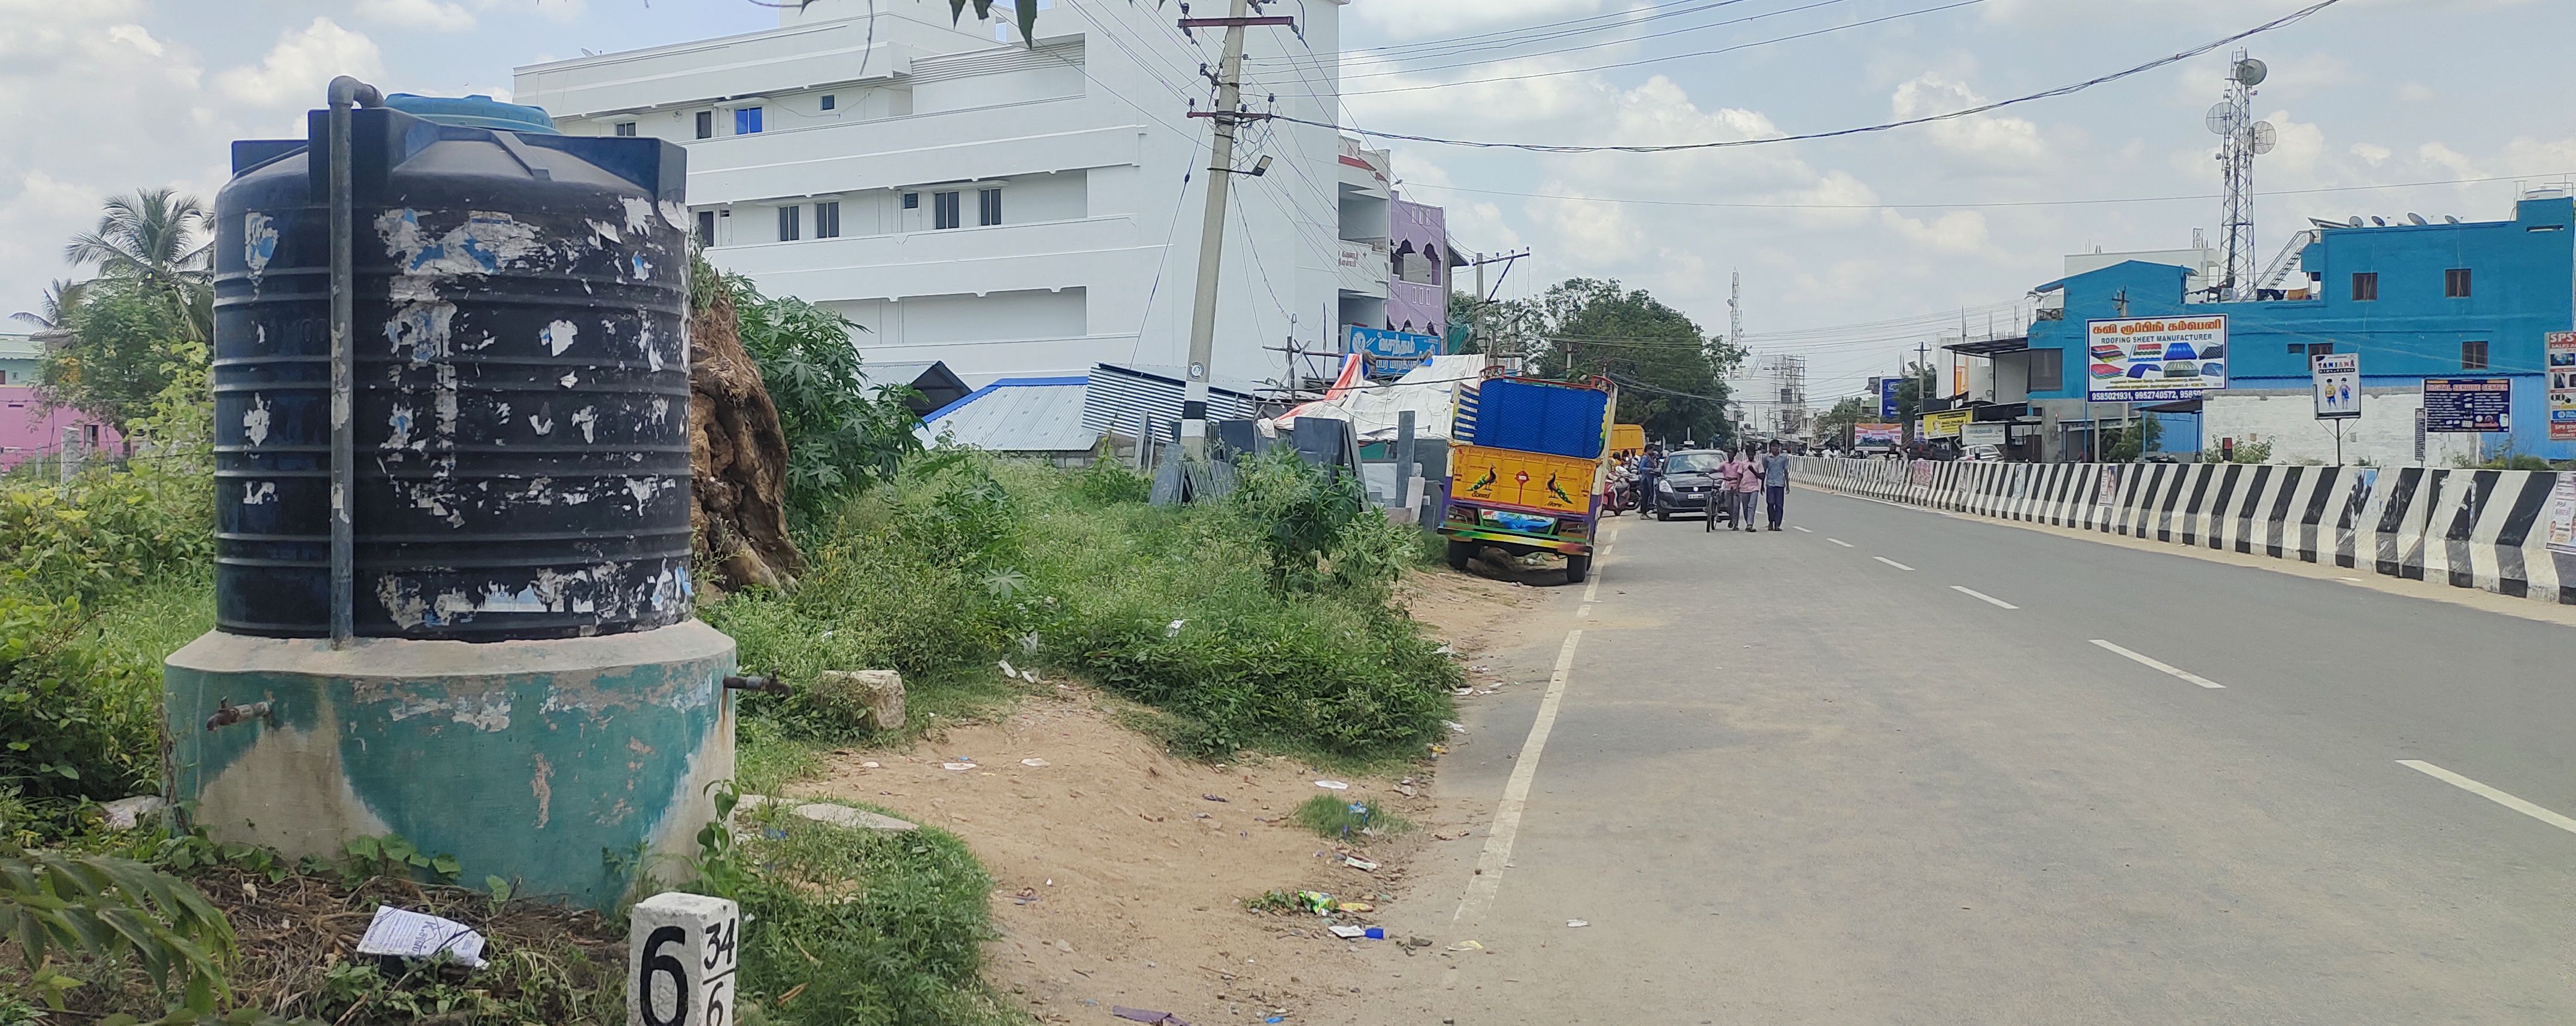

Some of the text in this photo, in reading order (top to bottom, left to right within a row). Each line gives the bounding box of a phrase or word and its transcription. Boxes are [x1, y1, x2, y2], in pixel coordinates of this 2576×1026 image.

[2093, 324, 2117, 334] கவி
[2168, 318, 2221, 331] கம்பெனி
[2156, 333, 2213, 342] MANUFACTURER
[2550, 333, 2576, 343] SPS
[2092, 391, 2133, 400] 9585021931,
[2135, 391, 2178, 399] 9952740572,
[704, 918, 736, 970] 34
[640, 925, 689, 1026] 6
[706, 981, 723, 1026] 6
